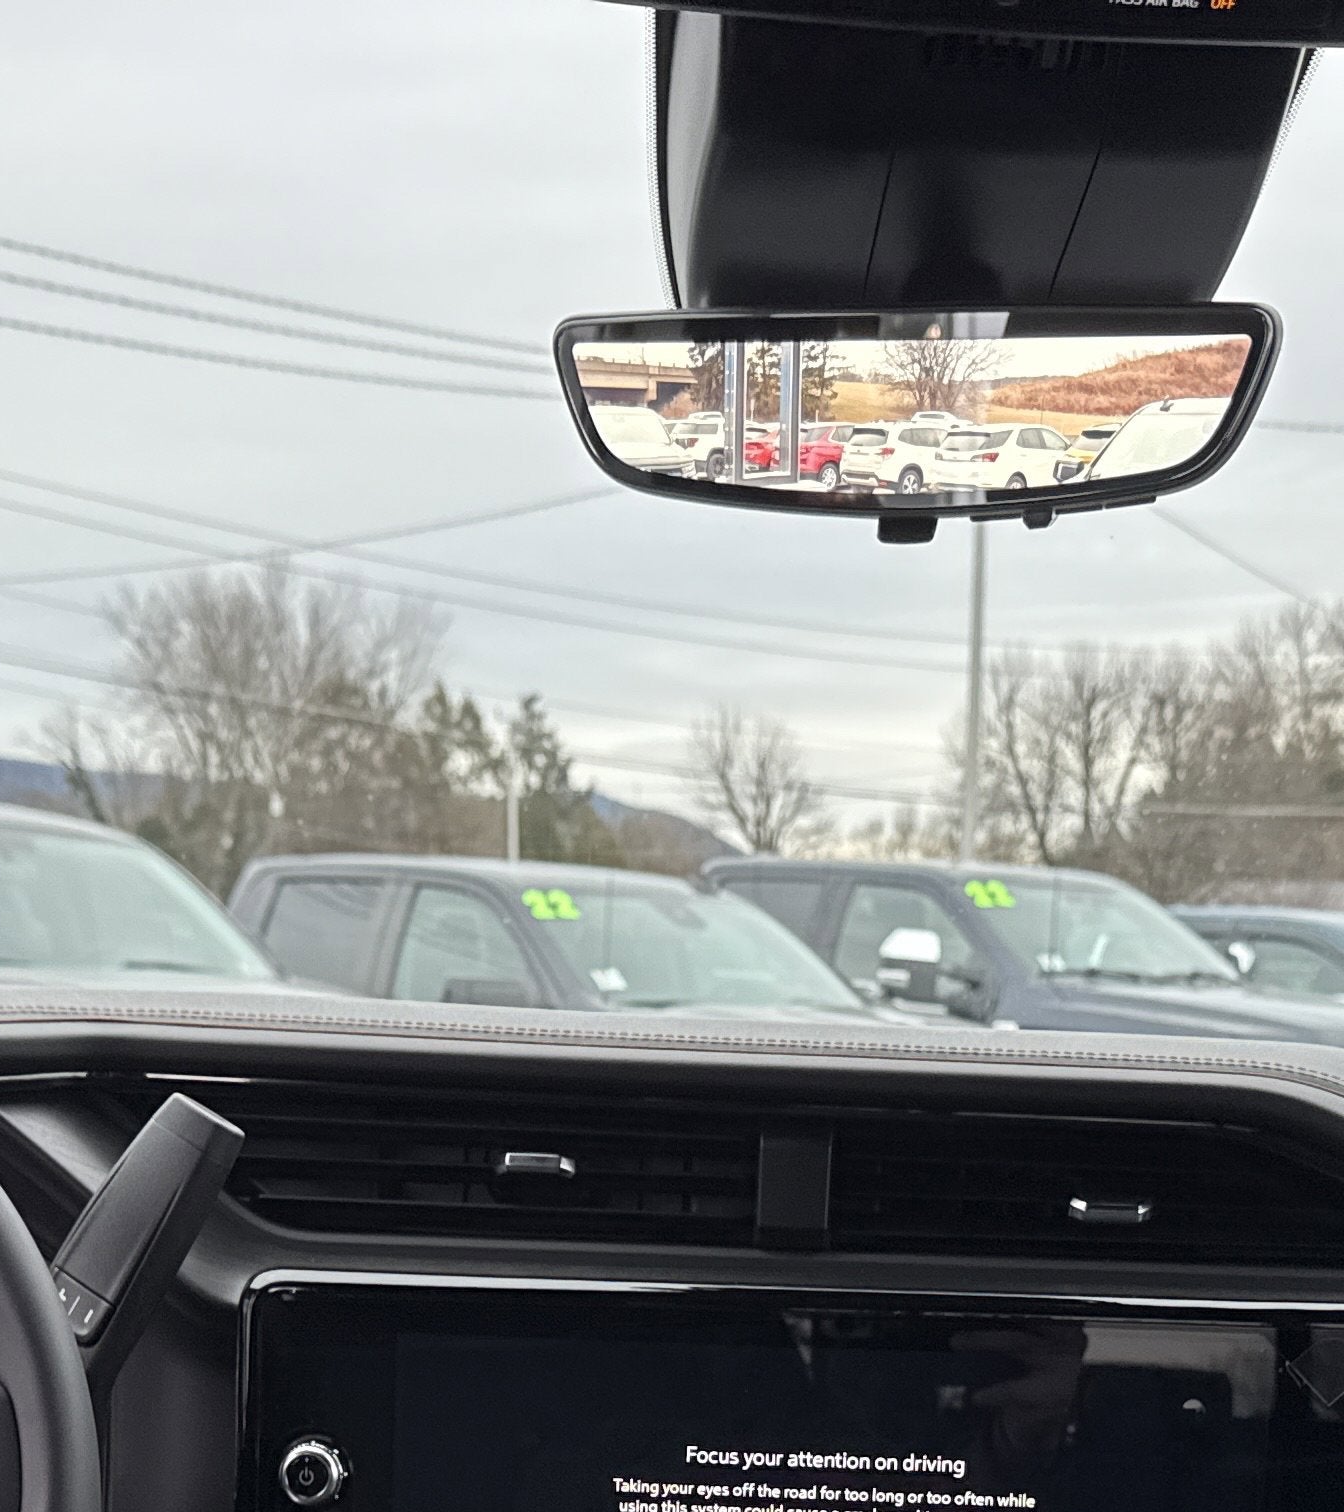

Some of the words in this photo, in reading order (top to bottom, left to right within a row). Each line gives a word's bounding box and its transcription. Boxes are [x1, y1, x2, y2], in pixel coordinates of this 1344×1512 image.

[1210, 0, 1235, 9] OFF
[521, 889, 581, 920] 22
[686, 1446, 739, 1465] Focus
[742, 1452, 783, 1470] your
[787, 1451, 870, 1470] attention
[875, 1456, 897, 1471] on
[903, 1453, 965, 1479] driving
[613, 1478, 659, 1497] Taking
[662, 1482, 694, 1497] your
[697, 1485, 729, 1499] eyes
[733, 1483, 755, 1497] off
[757, 1485, 780, 1499] the
[784, 1486, 816, 1500] road
[820, 1486, 841, 1501] for
[844, 1489, 868, 1502] too
[872, 1488, 904, 1507] long
[907, 1492, 924, 1503] or
[927, 1491, 951, 1505] too
[954, 1491, 993, 1506] often
[997, 1493, 1035, 1508] while
